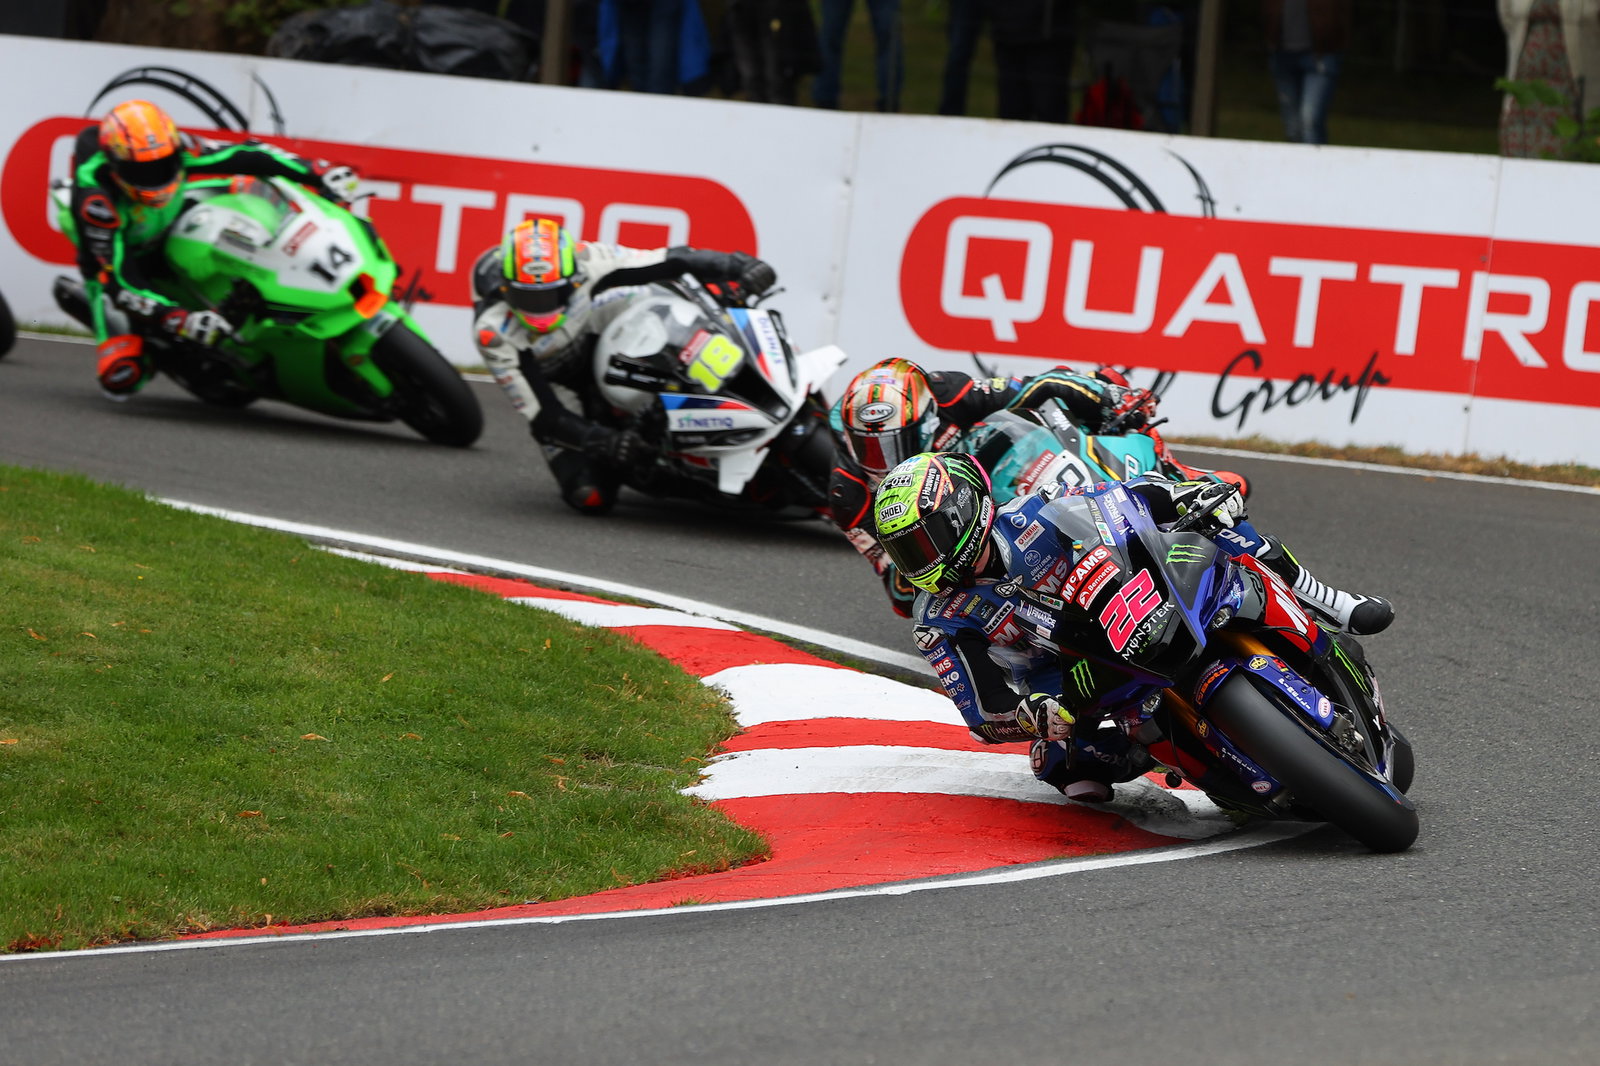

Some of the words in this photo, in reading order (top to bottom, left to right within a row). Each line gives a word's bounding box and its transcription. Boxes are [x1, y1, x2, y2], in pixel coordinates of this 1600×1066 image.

[309, 244, 354, 286] 14
[687, 333, 745, 392] 18
[1211, 349, 1392, 432] Group
[880, 503, 902, 520] SHOEI
[954, 525, 982, 570] MONSTER
[1062, 548, 1109, 601] McAMS
[1087, 564, 1115, 592] Bennetts
[943, 592, 967, 619] McAMS
[1099, 567, 1163, 652] 22
[1121, 601, 1175, 661] MONSTER
[1277, 678, 1312, 710] PIRELLI
